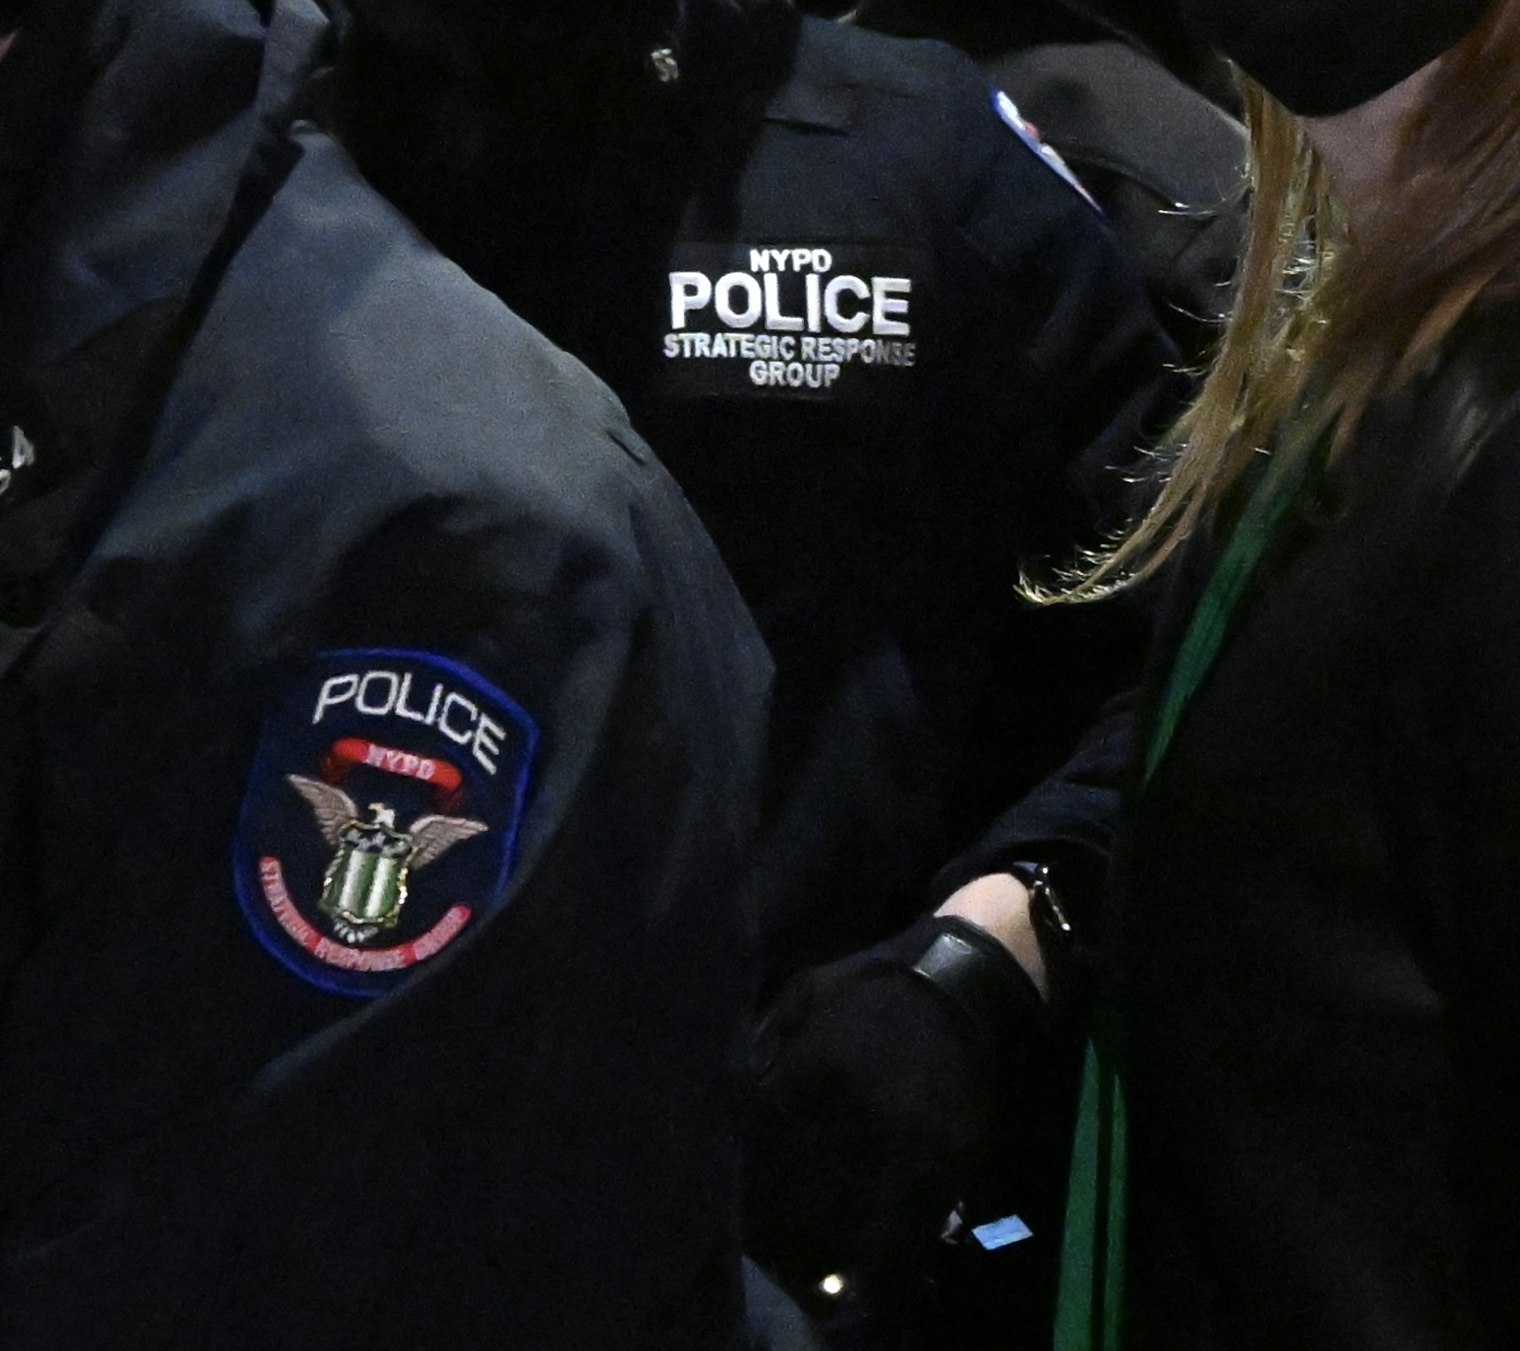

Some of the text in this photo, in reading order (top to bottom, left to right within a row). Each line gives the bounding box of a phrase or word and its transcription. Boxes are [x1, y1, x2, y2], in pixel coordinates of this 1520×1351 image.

[749, 248, 833, 273] NYPD
[668, 271, 911, 337] POLICE
[662, 332, 917, 367] STRATEGIC RESPONSE
[749, 361, 842, 389] GROUP
[312, 671, 507, 775] POLICE
